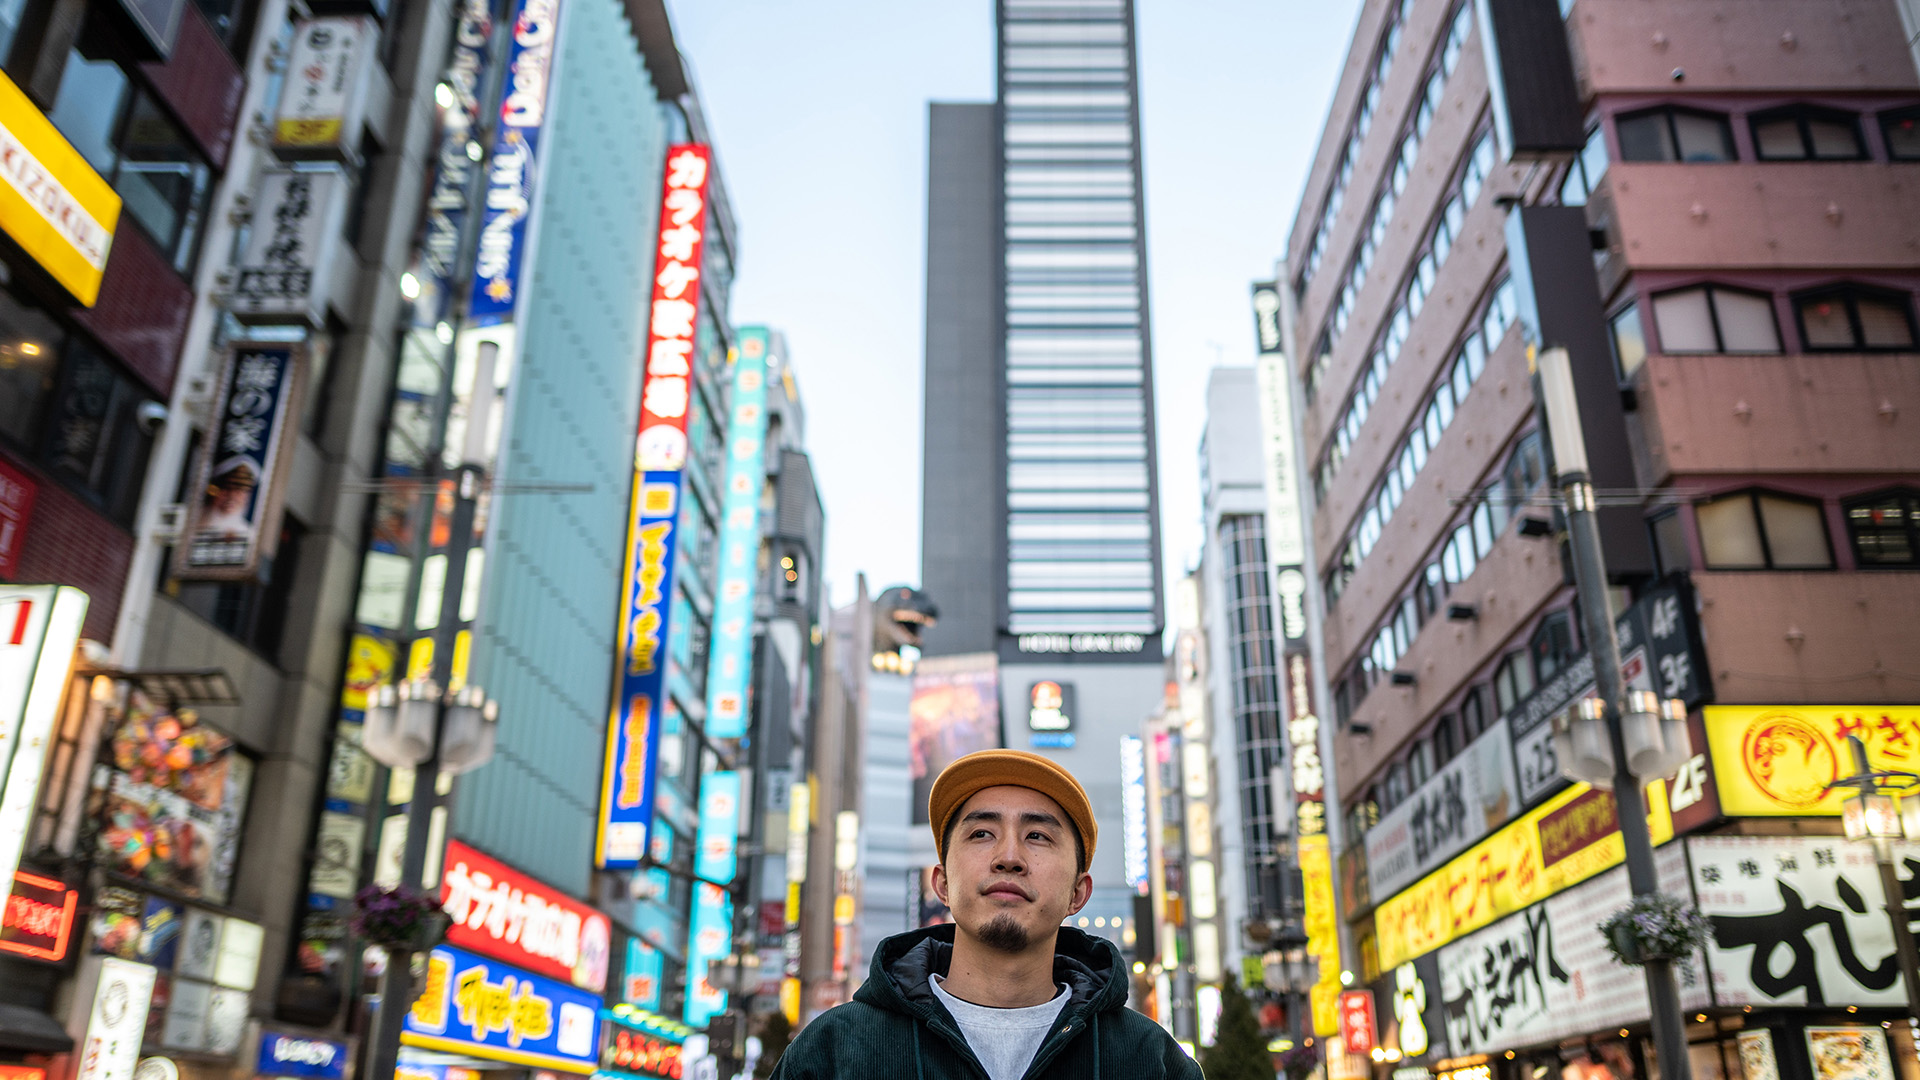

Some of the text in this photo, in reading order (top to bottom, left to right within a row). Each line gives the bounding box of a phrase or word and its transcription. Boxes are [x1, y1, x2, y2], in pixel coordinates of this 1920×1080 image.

[1651, 594, 1680, 640] 4F
[1658, 650, 1692, 700] 3F
[1670, 753, 1708, 813] 2F
